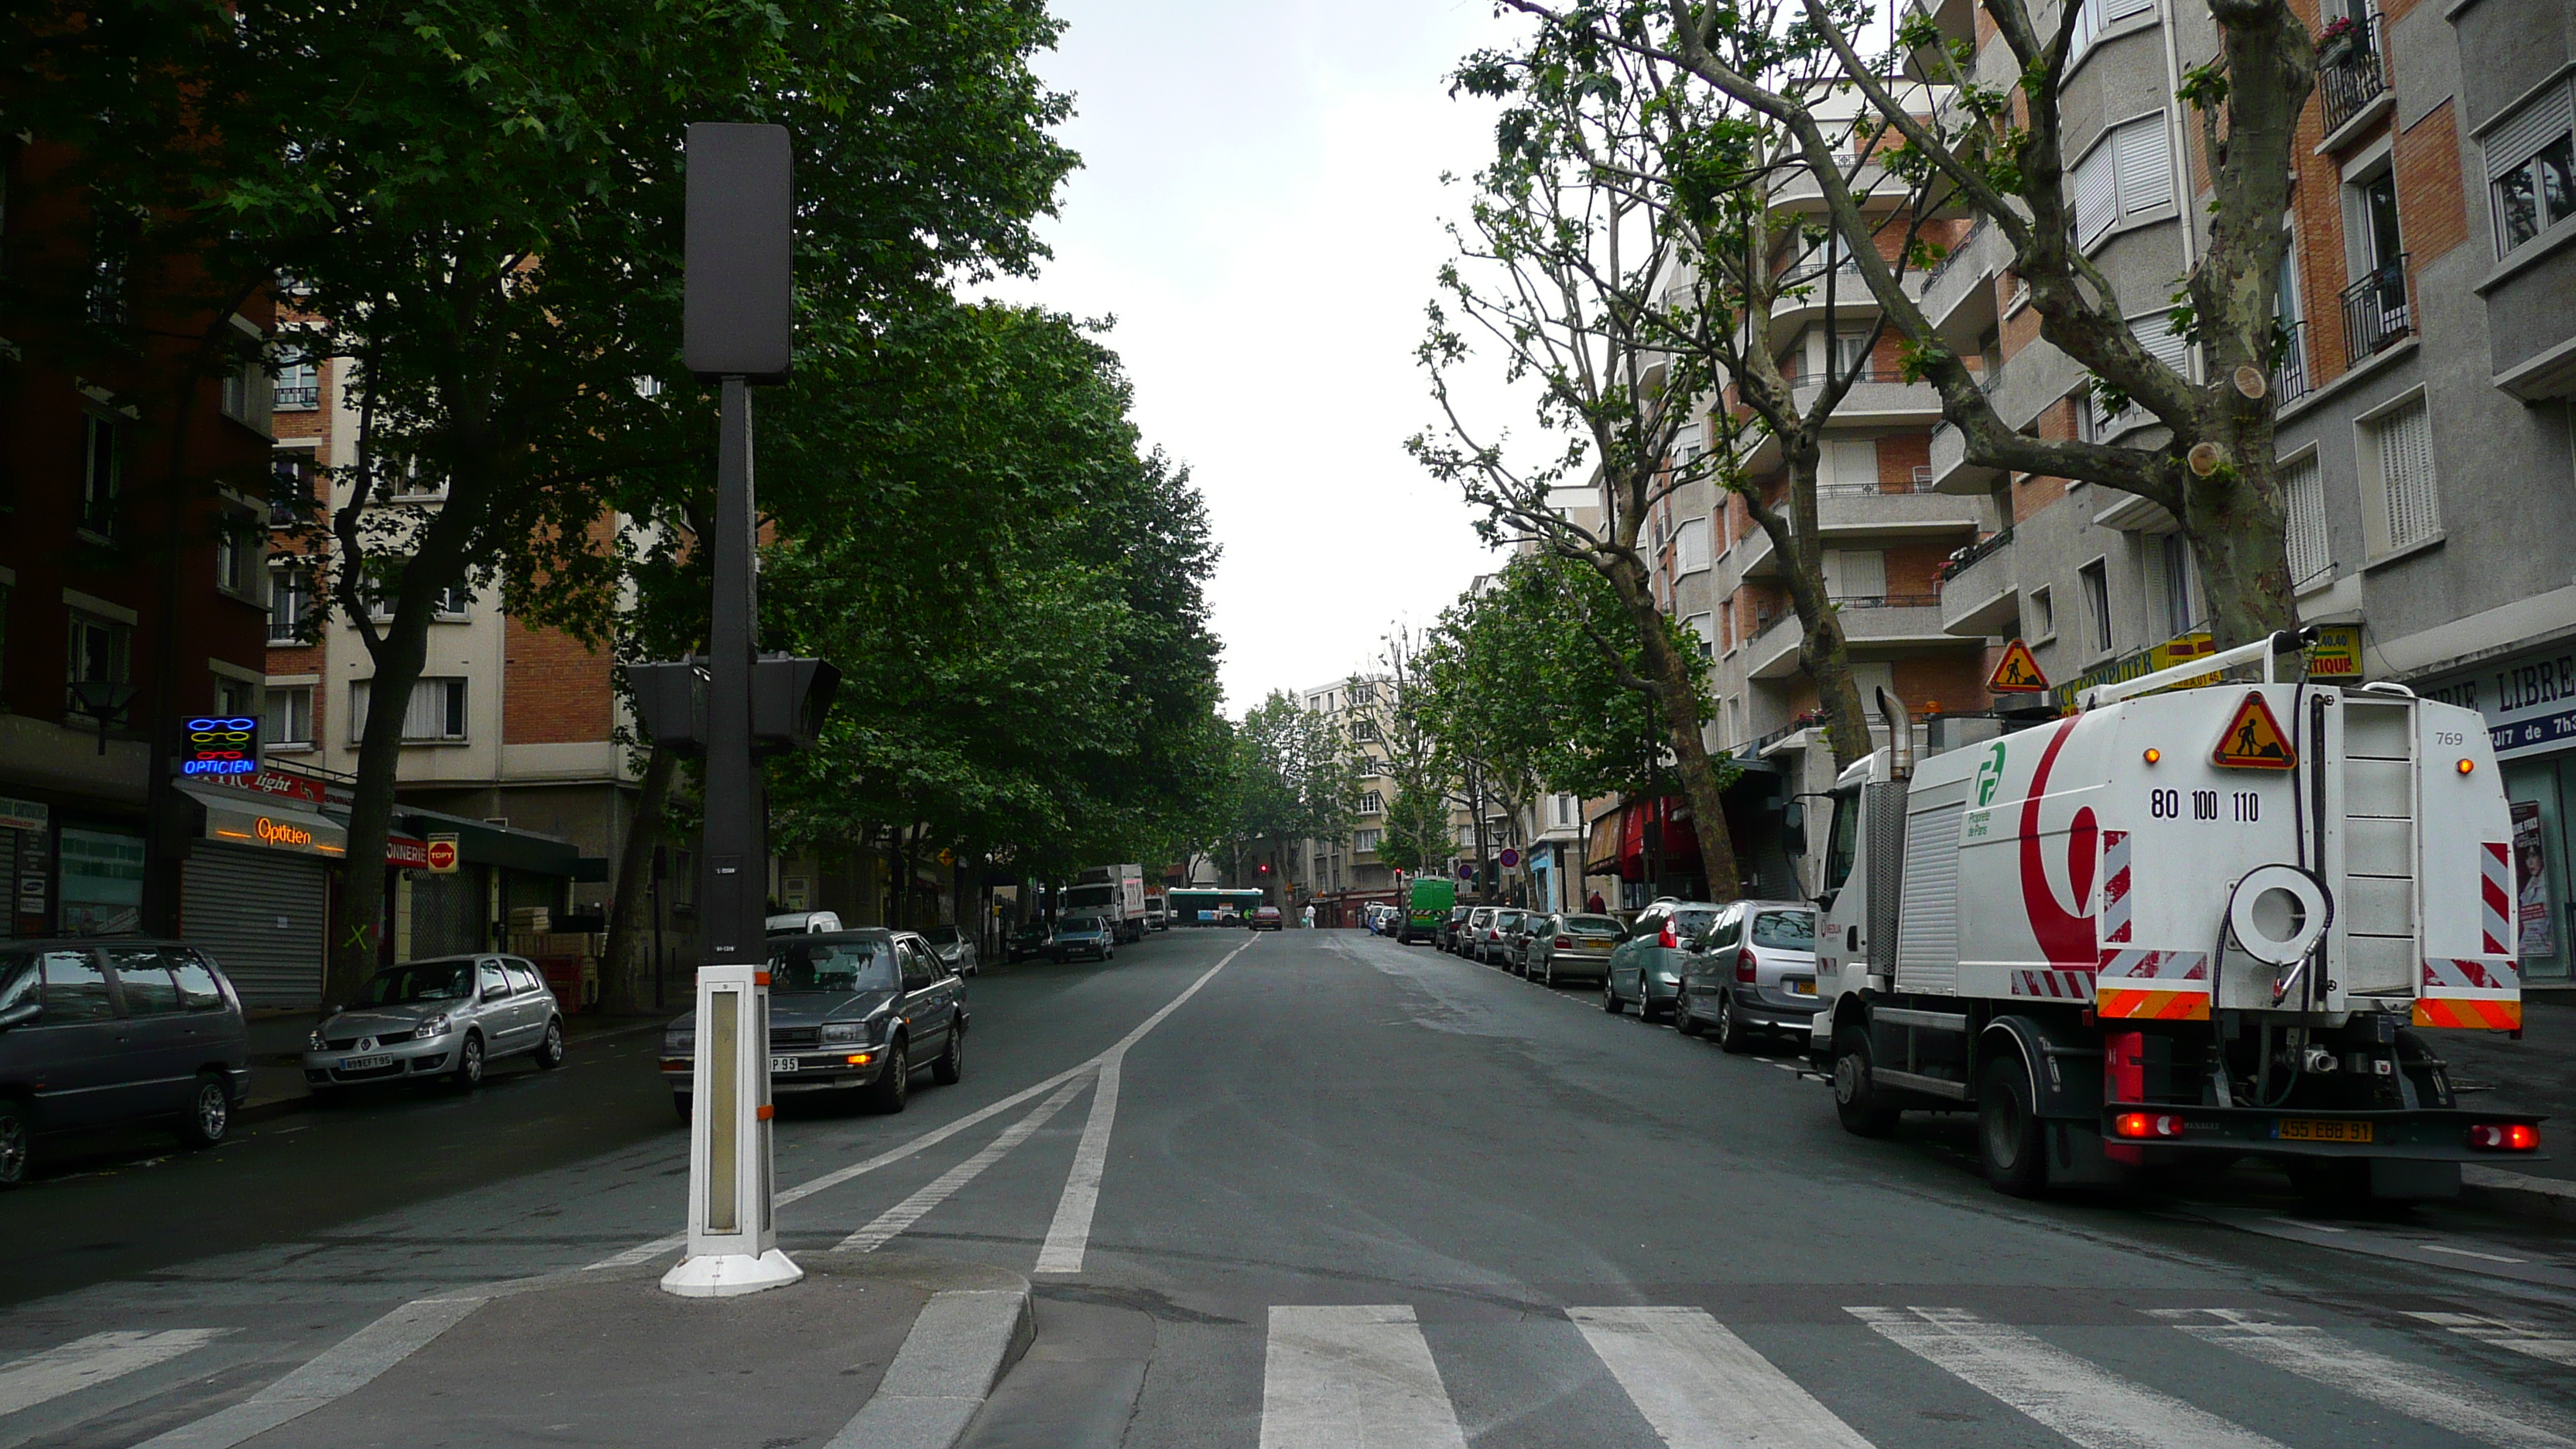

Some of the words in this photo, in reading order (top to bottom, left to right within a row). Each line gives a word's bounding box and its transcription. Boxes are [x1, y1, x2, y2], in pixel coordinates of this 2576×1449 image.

[2310, 657, 2352, 674] TIQUE
[2436, 732, 2463, 745] 769
[2525, 724, 2542, 740] de
[183, 759, 255, 774] OPTICIEN
[254, 772, 292, 793] light
[2152, 788, 2179, 819] 80
[2191, 790, 2218, 820] 100
[2232, 791, 2259, 822] 110
[255, 817, 311, 845] Opticien
[430, 851, 453, 860] TOPY
[782, 1058, 795, 1070] 95
[2280, 1122, 2309, 1138] 455
